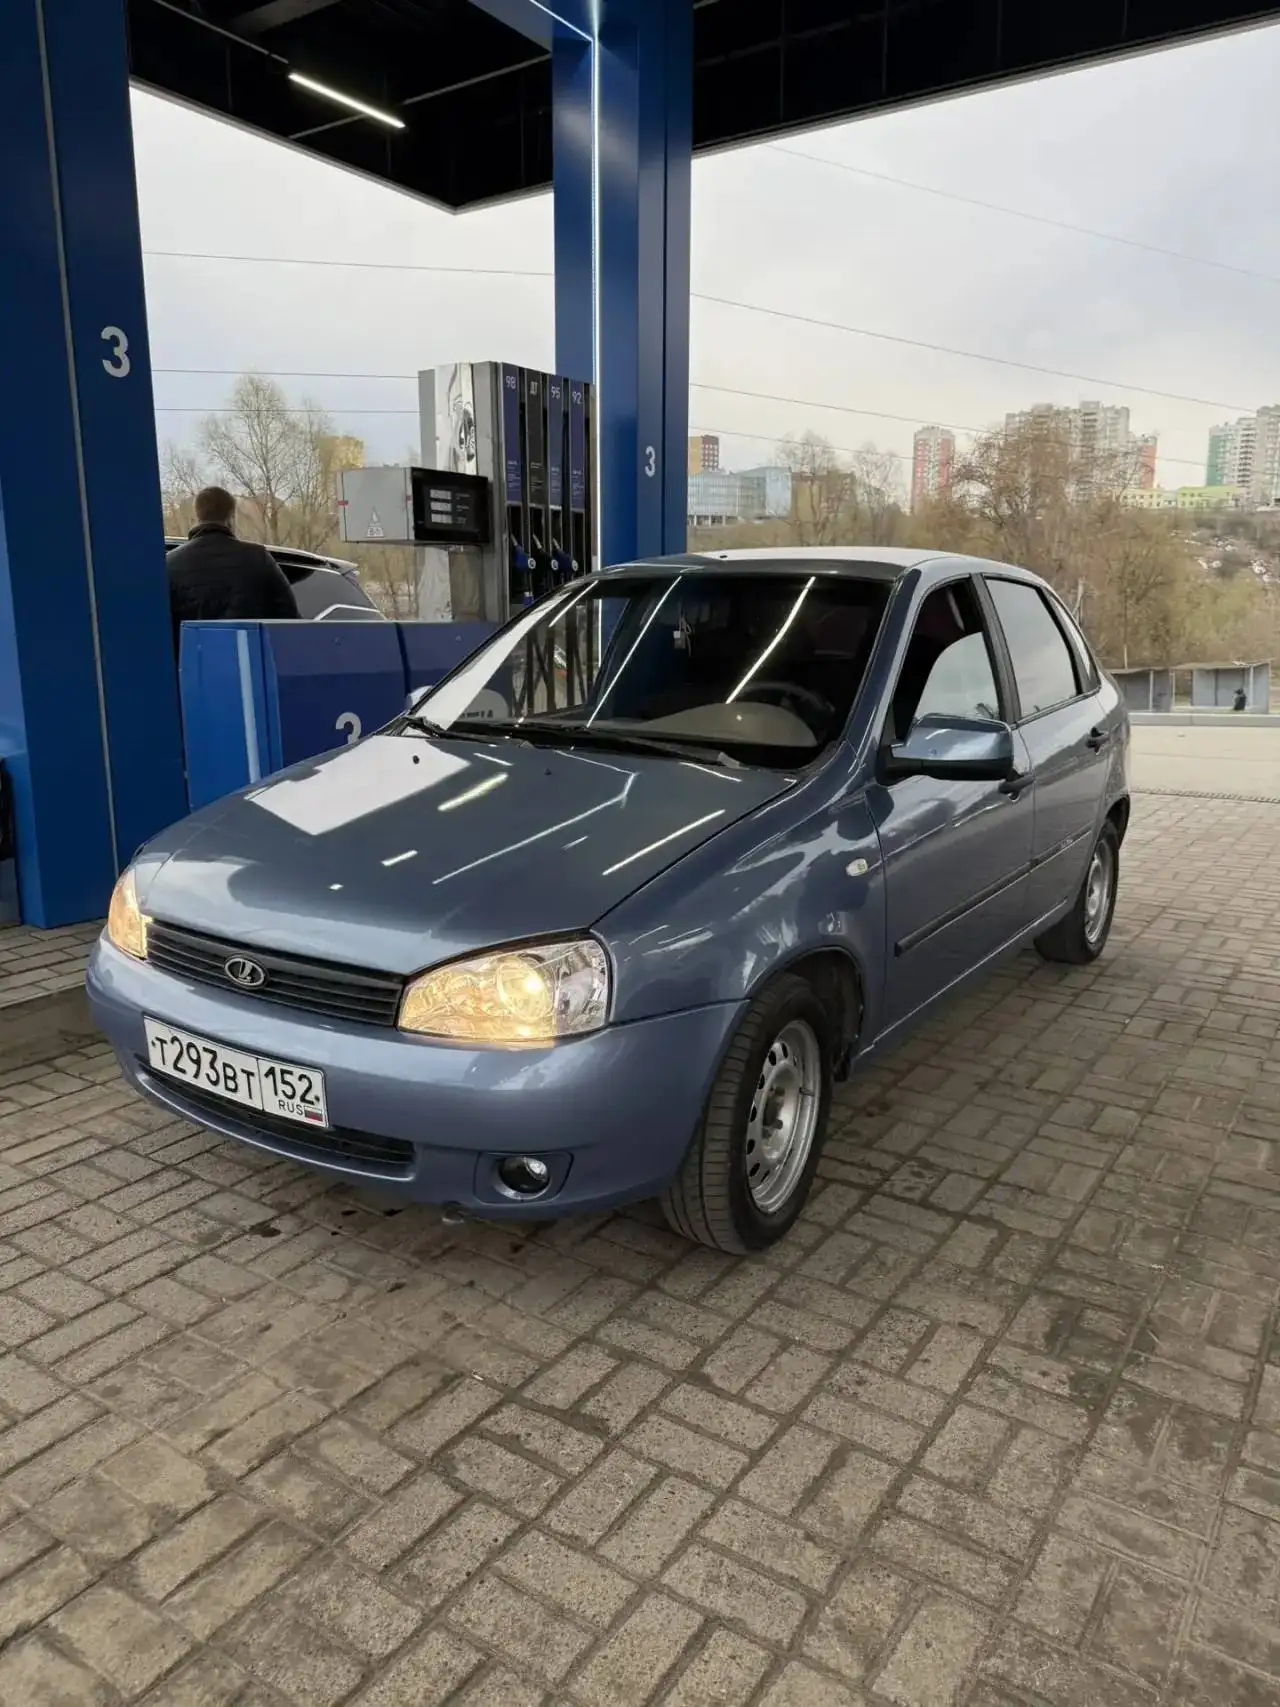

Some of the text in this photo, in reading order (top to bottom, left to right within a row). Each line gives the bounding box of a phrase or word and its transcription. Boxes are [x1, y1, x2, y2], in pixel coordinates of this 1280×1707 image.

[101, 326, 130, 377] 3
[506, 375, 516, 389] 98
[551, 386, 560, 399] 95
[572, 391, 581, 404] 92
[645, 446, 655, 477] 3
[264, 1066, 315, 1105] 152
[278, 1100, 304, 1116] RUS
